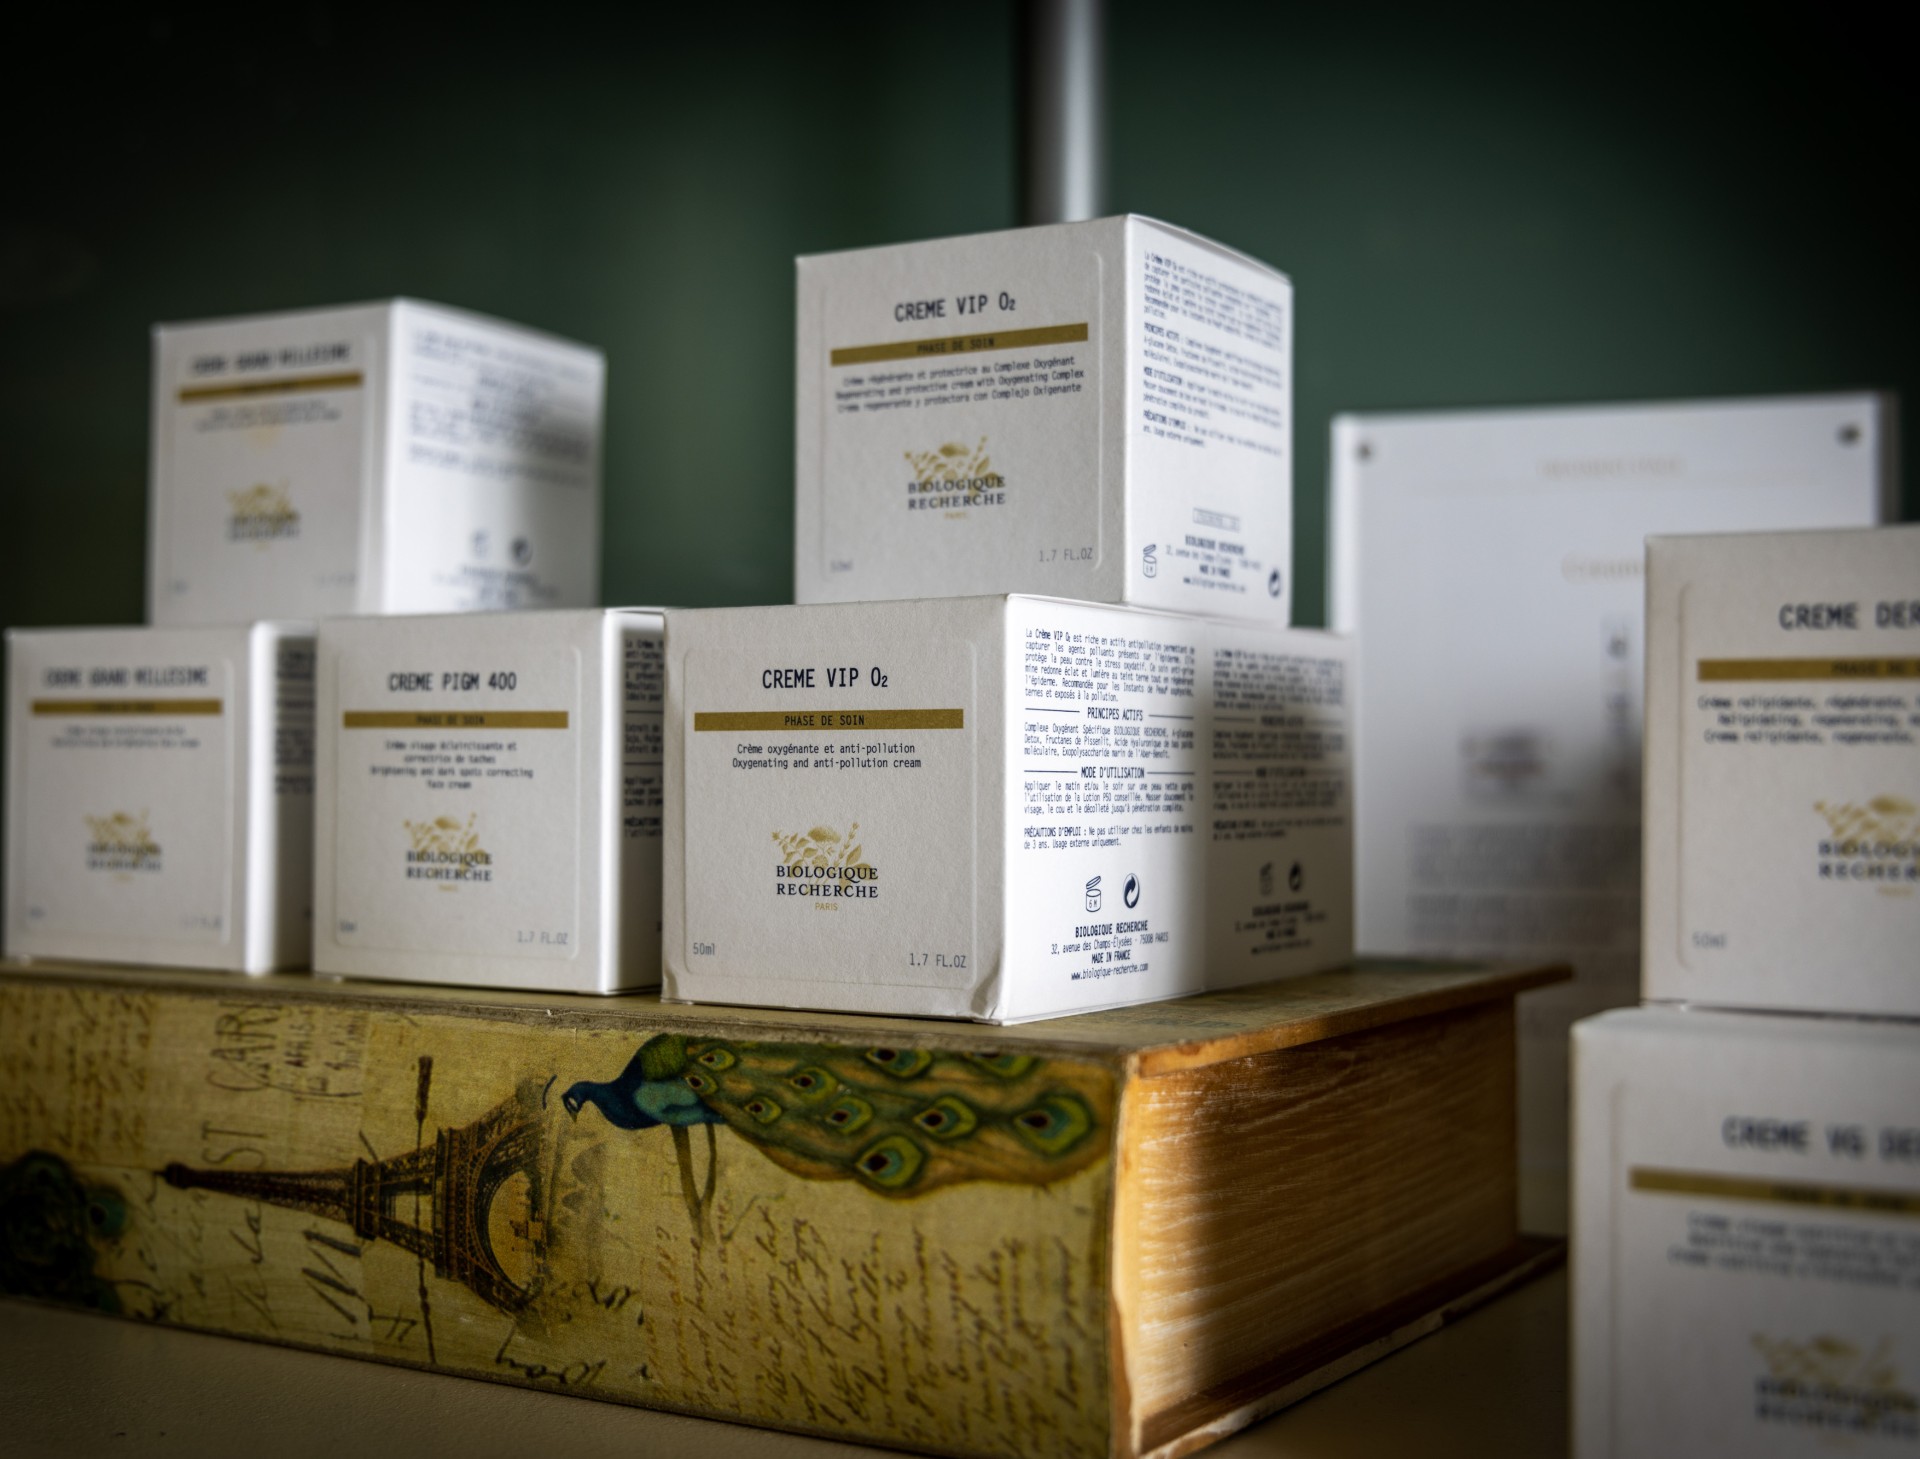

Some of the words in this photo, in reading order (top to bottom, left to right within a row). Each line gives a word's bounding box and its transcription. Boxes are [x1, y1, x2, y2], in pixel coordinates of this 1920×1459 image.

[895, 298, 946, 322] CREME
[957, 295, 988, 315] VIP
[917, 342, 946, 354] PHASE
[952, 340, 964, 352] DE
[970, 338, 995, 350] SOIN
[930, 365, 977, 380] protectrice
[994, 361, 1030, 375] Complexe
[1033, 356, 1075, 370] Oxygénant
[905, 380, 947, 397] protective
[977, 376, 995, 388] with
[998, 372, 1048, 388] Oxygenating
[1052, 369, 1084, 382] Complex
[924, 393, 970, 407] protectora
[973, 392, 988, 402] con
[992, 387, 1030, 402] Complejo
[1033, 382, 1082, 397] Oxigenante
[907, 476, 1006, 495] BIOLOGIQUE
[908, 492, 1006, 510] RECHERCHE
[1039, 549, 1057, 562] 1.7
[1063, 547, 1093, 561] FL.OZ
[1779, 602, 1858, 630] CREME
[1035, 628, 1051, 640] Crème
[1054, 630, 1063, 641] VIP
[1084, 635, 1099, 645] riche
[1109, 637, 1126, 647] actifs
[1128, 639, 1162, 651] antipollution
[1025, 641, 1050, 651] capturer
[1068, 644, 1086, 655] agents
[1089, 646, 1114, 658] polluants
[1118, 649, 1139, 660] présents
[1025, 652, 1047, 664] protège
[1060, 656, 1073, 665] peau
[1075, 656, 1093, 666] contre
[1104, 660, 1121, 669] stress
[1149, 663, 1156, 673] Ce
[388, 672, 434, 691] CREME
[443, 672, 480, 691] PIGM
[488, 672, 517, 691] 400
[762, 669, 815, 689] CREME
[827, 667, 859, 688] VIP
[1041, 666, 1062, 676] redonne
[1064, 666, 1079, 677] éclat
[1090, 669, 1109, 679] lumière
[1120, 672, 1133, 681] teint
[1136, 673, 1149, 682] terne
[1062, 677, 1094, 689] Recommandée
[1097, 682, 1108, 690] pour
[1123, 682, 1144, 693] Instants
[1025, 687, 1043, 697] ternes
[1055, 689, 1075, 700] exposés
[1091, 691, 1119, 702] pollution.
[784, 715, 815, 726] PHASE
[821, 715, 833, 726] DE
[840, 715, 865, 726] SOIN
[1087, 706, 1120, 720] PRINCIPES
[1122, 709, 1144, 721] ACTIFS
[1024, 721, 1049, 733] Complexe
[1052, 723, 1079, 735] Oxygénant
[1082, 724, 1110, 735] Spécifique
[1114, 726, 1140, 736] BIOLOGIQUE
[1045, 734, 1072, 745] Fructanes
[1114, 738, 1128, 747] Acide
[737, 743, 763, 755] Crème
[767, 745, 819, 757] oxygénante
[824, 744, 835, 754] et
[840, 742, 915, 755] anti-pollution
[1062, 746, 1109, 758] Exopolysaccharide
[1112, 750, 1125, 758] marin
[732, 758, 788, 770] Oxygenating
[793, 758, 809, 768] and
[813, 758, 888, 769] anti-pollution
[893, 760, 922, 768] cream
[486, 767, 533, 778] correcting
[1081, 766, 1096, 778] MODE
[1099, 766, 1145, 779] D'UTILISATION
[1024, 781, 1051, 791] Appliquer
[1065, 782, 1080, 790] matin
[1084, 781, 1099, 790] et/ou
[1112, 782, 1123, 790] soir
[1024, 792, 1062, 802] l'utilisation
[1083, 793, 1100, 802] Lotion
[1102, 792, 1112, 802] P50
[1146, 793, 1161, 801] Masser
[1056, 805, 1065, 814] cou
[1084, 803, 1109, 813] décolleté
[1131, 803, 1161, 814] pénétration
[1024, 825, 1057, 838] PRÉCAUTIONS
[1058, 826, 1081, 837] D'EMPLOI
[1088, 826, 1095, 835] Ne
[1097, 828, 1105, 837] pas
[1107, 825, 1129, 835] utiliser
[1131, 825, 1142, 834] chez
[1032, 839, 1036, 849] 3
[1038, 841, 1050, 849] ans.
[1052, 839, 1067, 850] Usage
[1069, 839, 1090, 847] externe
[1091, 838, 1122, 848] uniquement.
[406, 851, 493, 866] BIOLOGIQUE
[406, 867, 493, 882] RECHERCHE
[776, 865, 879, 884] BIOLOGIQUE
[776, 883, 879, 898] RECHERCHE
[815, 902, 839, 911] PARIS
[1088, 900, 1093, 908] 6
[1093, 899, 1098, 907] M
[1075, 923, 1113, 938] BIOLOGIQUE
[1116, 920, 1148, 934] RECHERCHE
[517, 931, 535, 944] 1.7
[540, 931, 568, 945] FL.OZ
[1051, 943, 1060, 955] 32,
[1062, 942, 1081, 953] avenue
[1082, 941, 1092, 951] des
[1093, 934, 1132, 950] Champs-Élysées
[1139, 933, 1153, 945] 75008
[1154, 931, 1168, 943] PARIS
[692, 943, 716, 955] 50ml
[1091, 951, 1104, 964] MADE
[1106, 951, 1112, 962] IN
[1114, 949, 1131, 962] FRANCE
[909, 953, 928, 967] 1.7
[935, 954, 967, 969] FL.OZ
[1071, 962, 1149, 980] www.biologique-recherche.com
[1721, 1115, 1809, 1153] CREME
